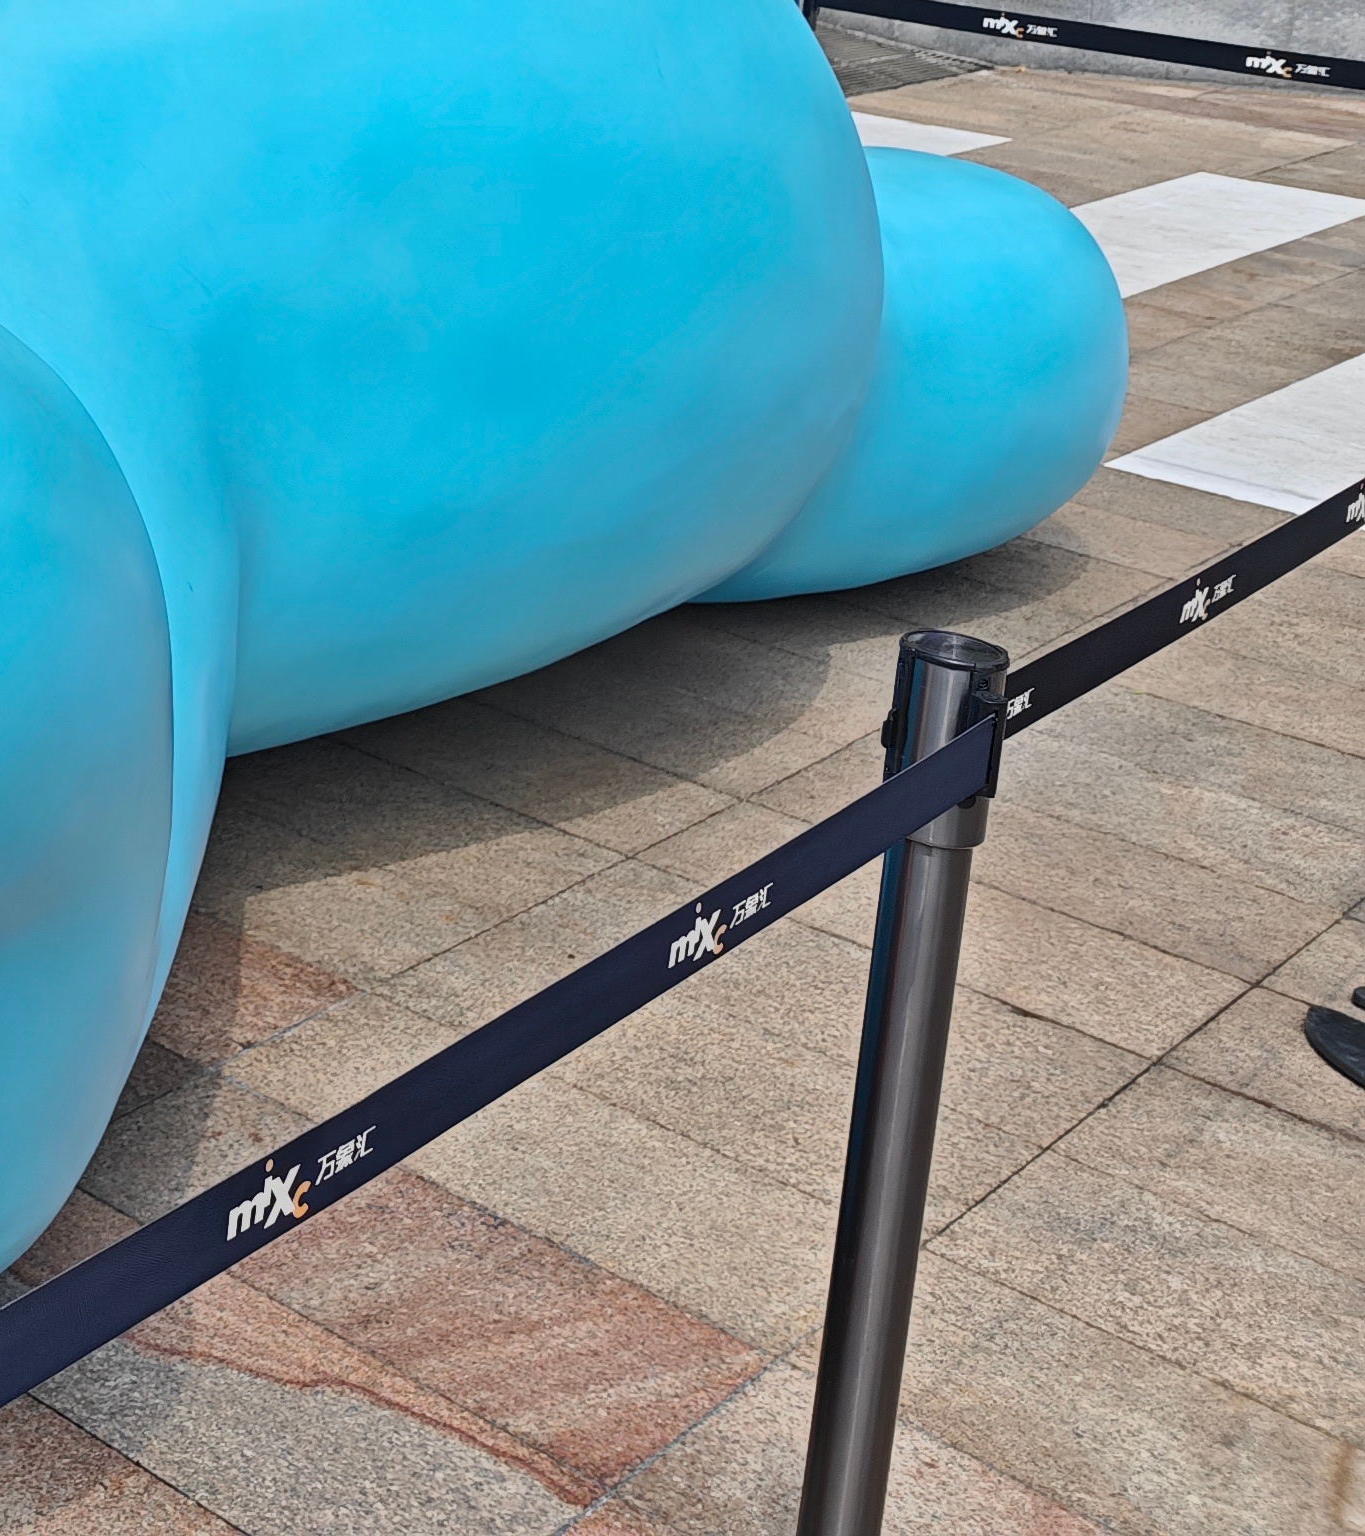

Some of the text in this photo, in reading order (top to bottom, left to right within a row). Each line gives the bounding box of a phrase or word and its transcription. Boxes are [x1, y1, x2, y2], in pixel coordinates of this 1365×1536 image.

[729, 882, 774, 929] 万象汇
[315, 1125, 377, 1186] 万象汇
